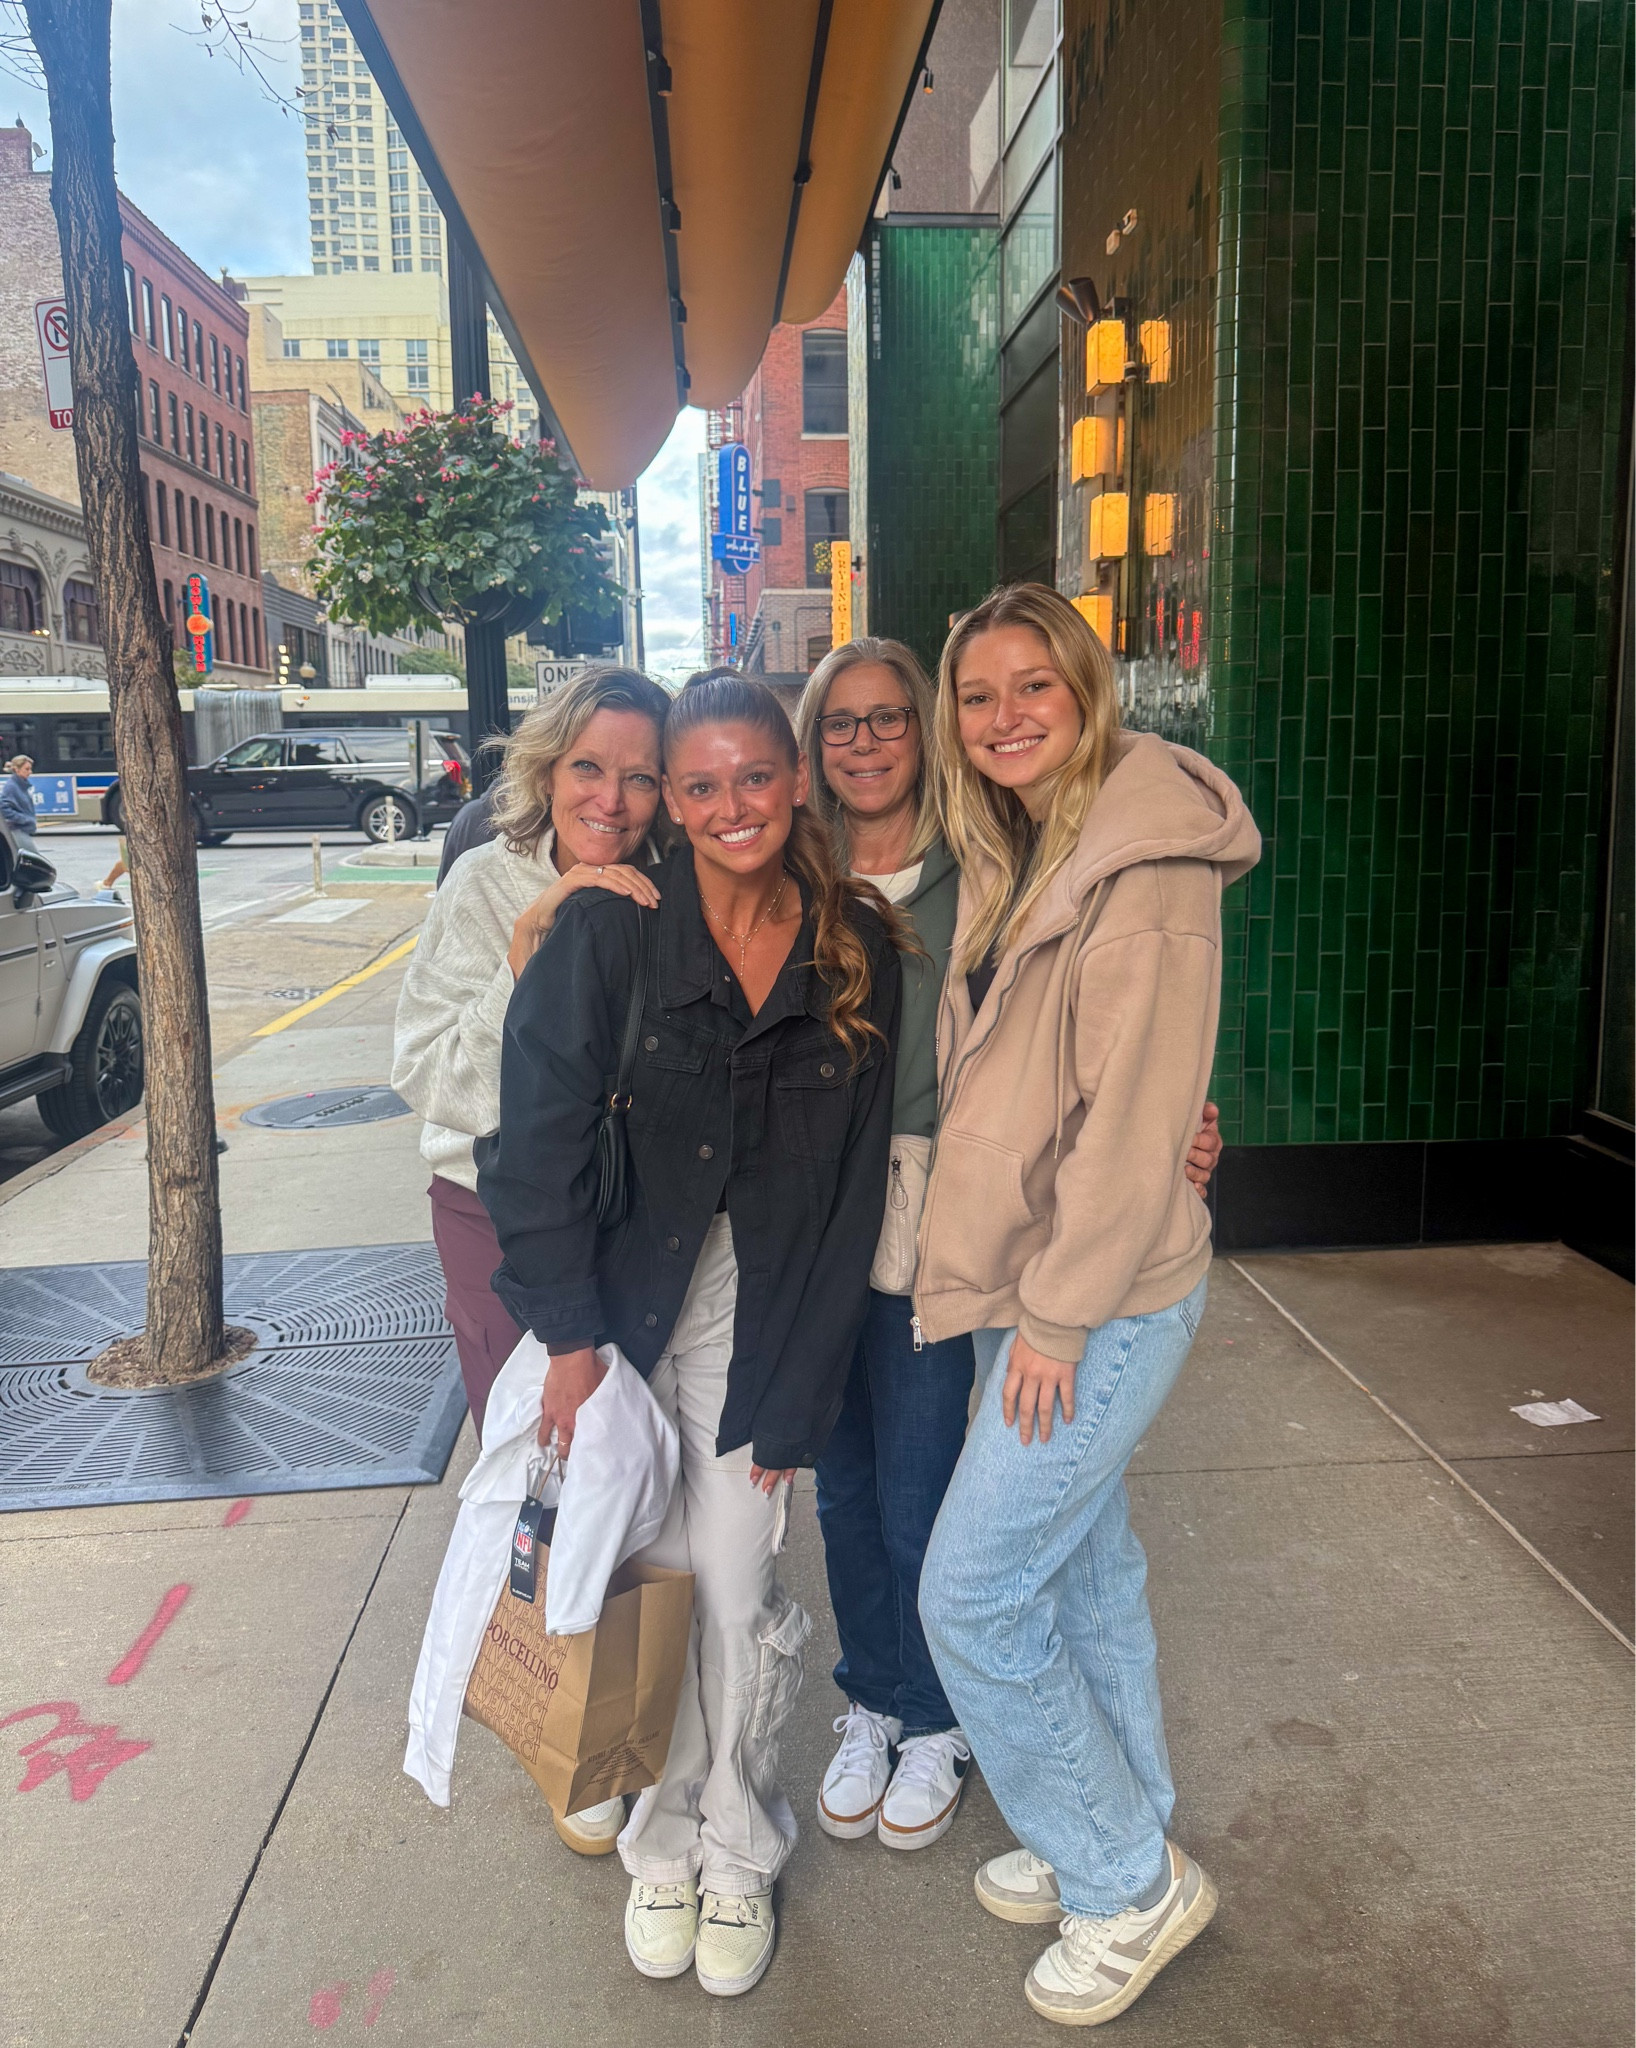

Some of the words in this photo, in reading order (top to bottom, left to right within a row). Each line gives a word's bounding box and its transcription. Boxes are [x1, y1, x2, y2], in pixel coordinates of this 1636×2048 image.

[54, 409, 73, 427] TO
[737, 455, 748, 532] BLUE
[837, 549, 847, 613] CRYING
[516, 1531, 532, 1553] NFL
[514, 1557, 530, 1570] TEAM
[1142, 1929, 1158, 1946] Gola
